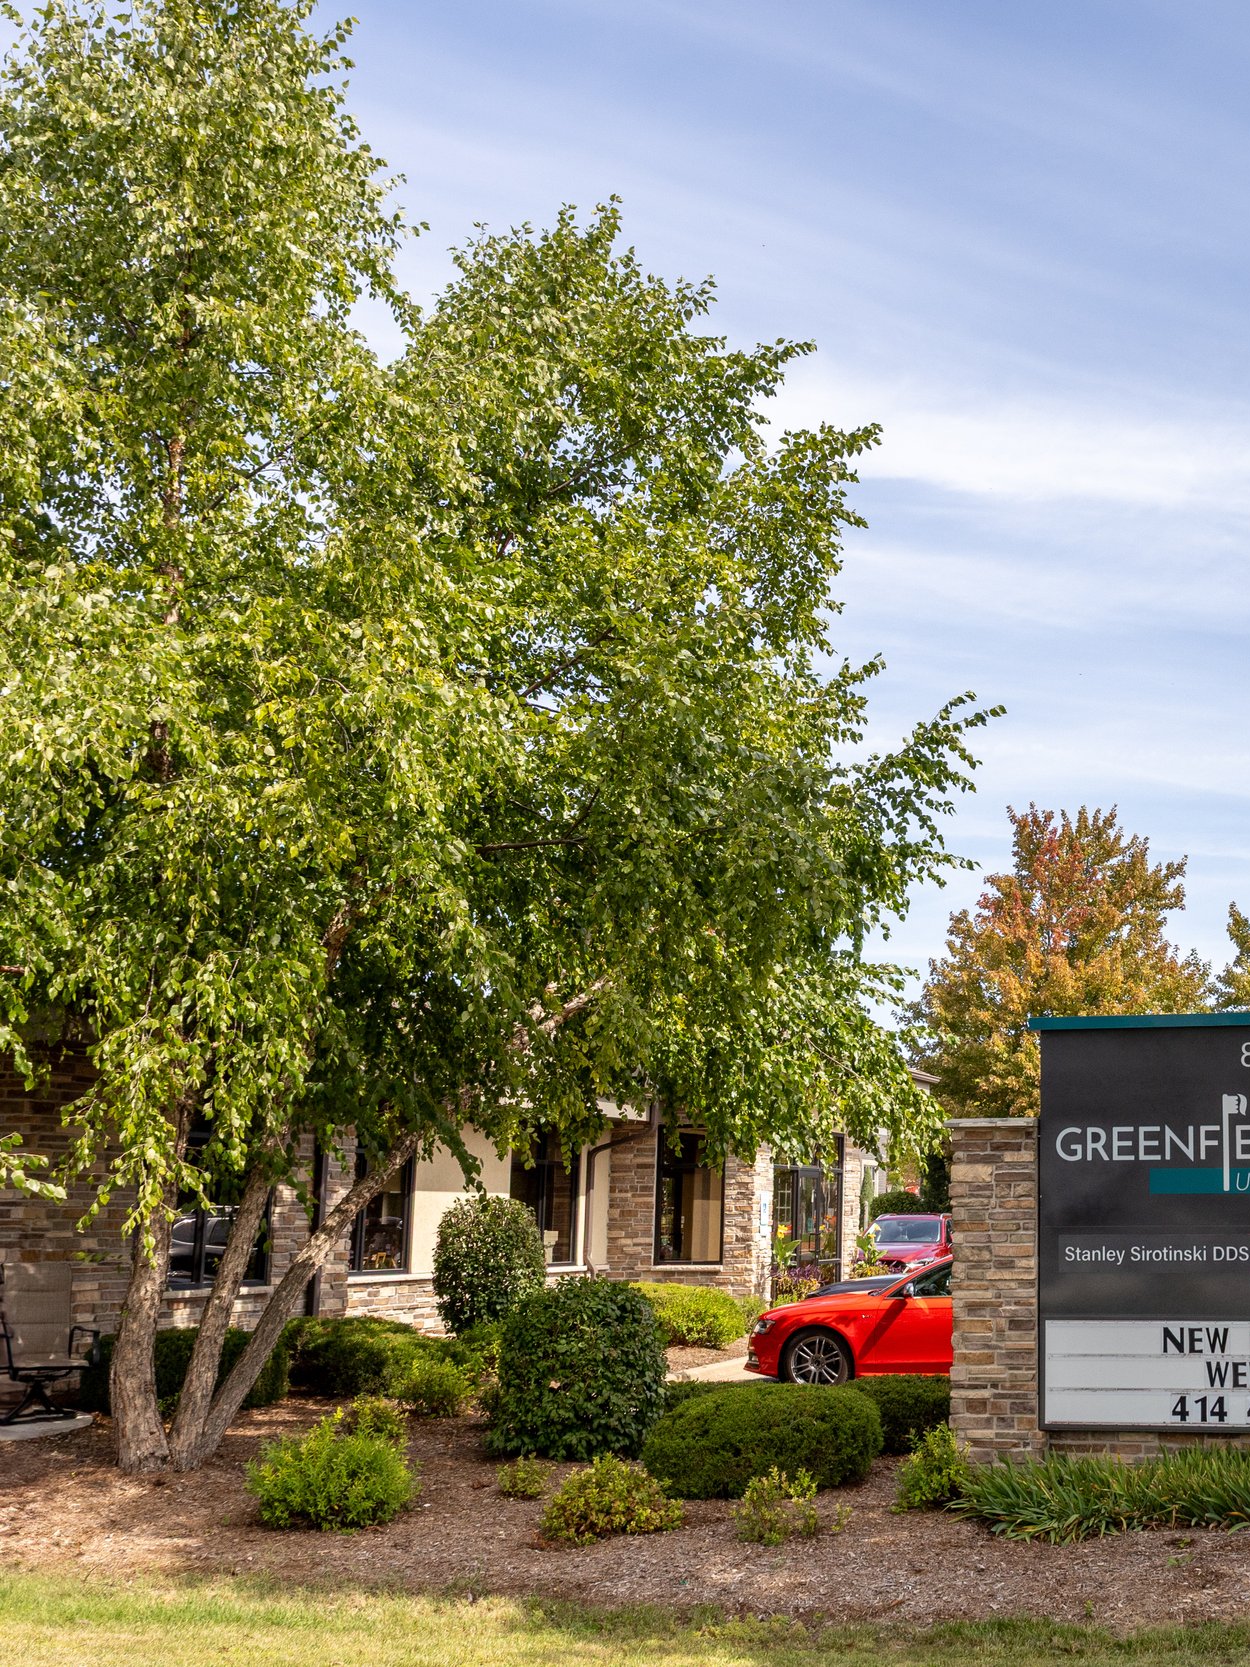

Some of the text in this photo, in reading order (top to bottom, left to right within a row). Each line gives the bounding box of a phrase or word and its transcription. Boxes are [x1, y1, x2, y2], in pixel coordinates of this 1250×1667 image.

[1064, 1245, 1250, 1265] Stanley Sirotinski DDS
[1162, 1326, 1229, 1354] NEW
[1171, 1395, 1228, 1423] 414
